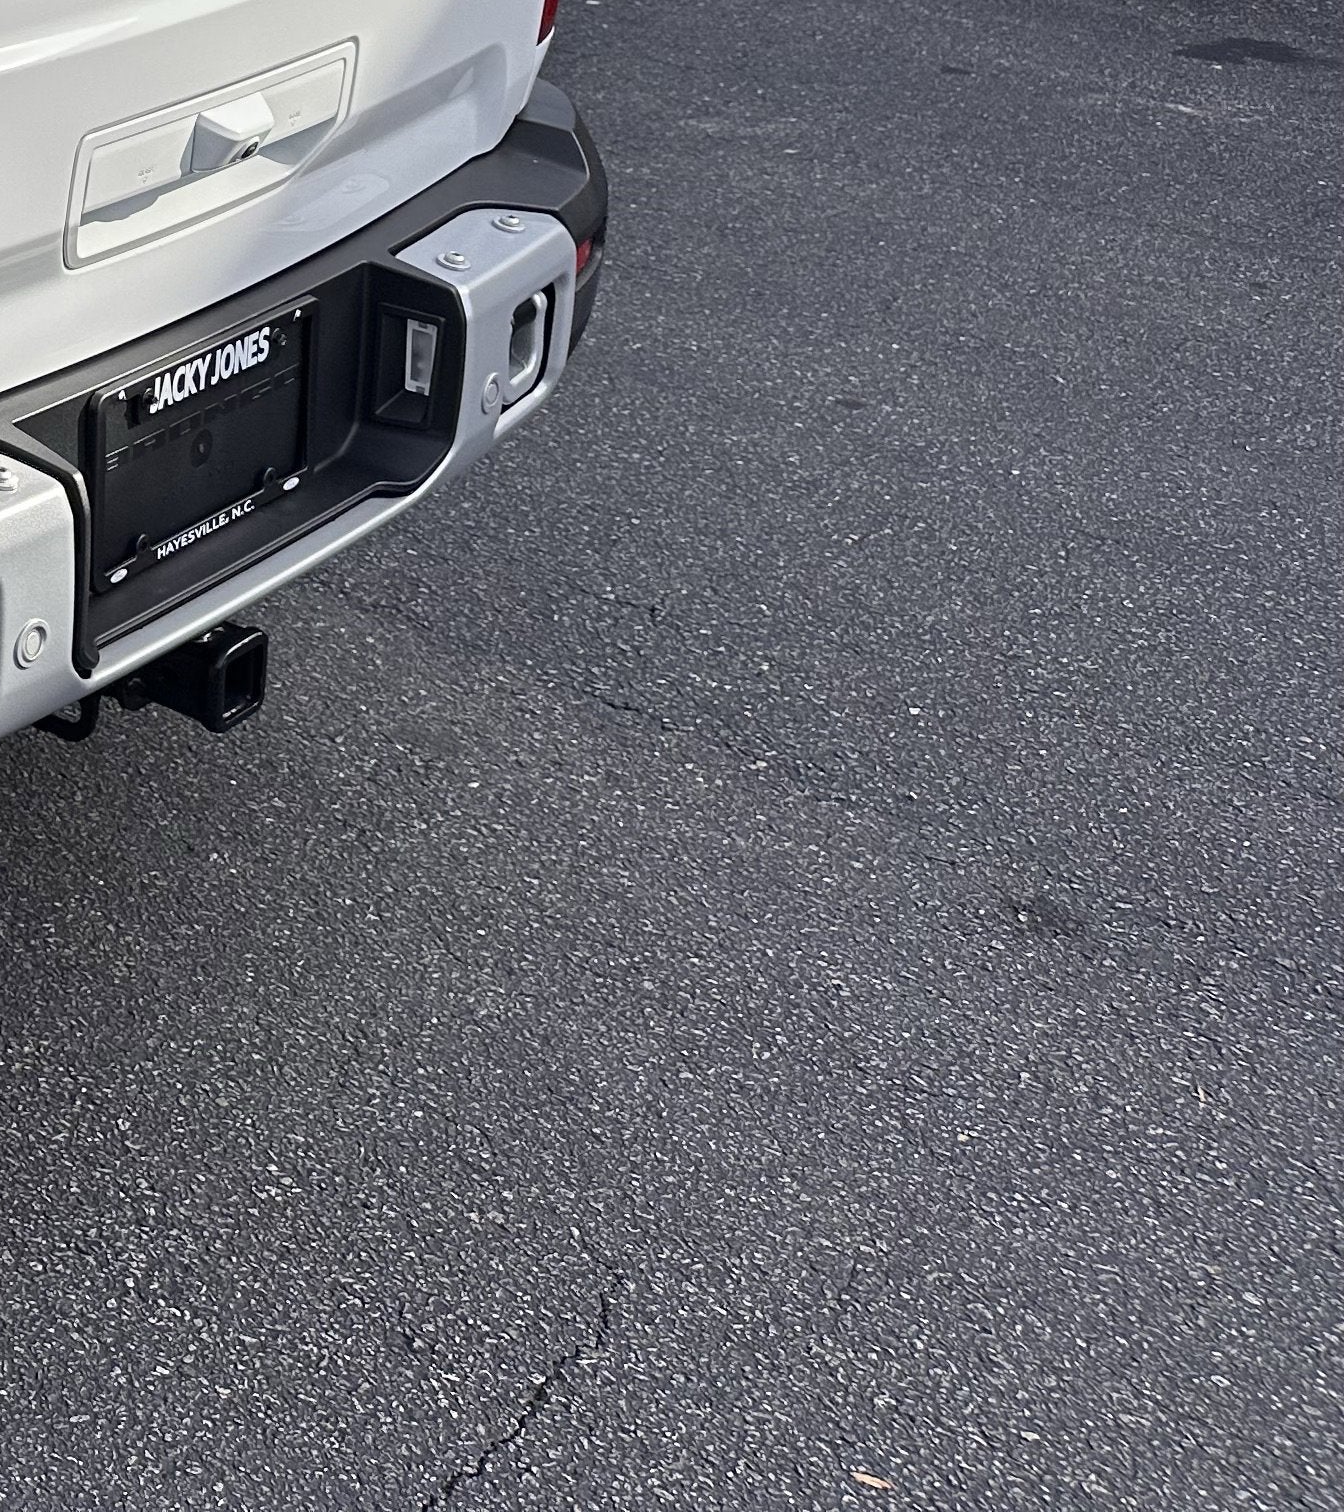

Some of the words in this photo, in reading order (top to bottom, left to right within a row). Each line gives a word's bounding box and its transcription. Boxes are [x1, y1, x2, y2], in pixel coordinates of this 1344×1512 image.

[149, 352, 212, 415] JACKY
[210, 326, 271, 386] JONES
[156, 513, 230, 560] HAYESVILLE,
[231, 499, 256, 520] N.C.
